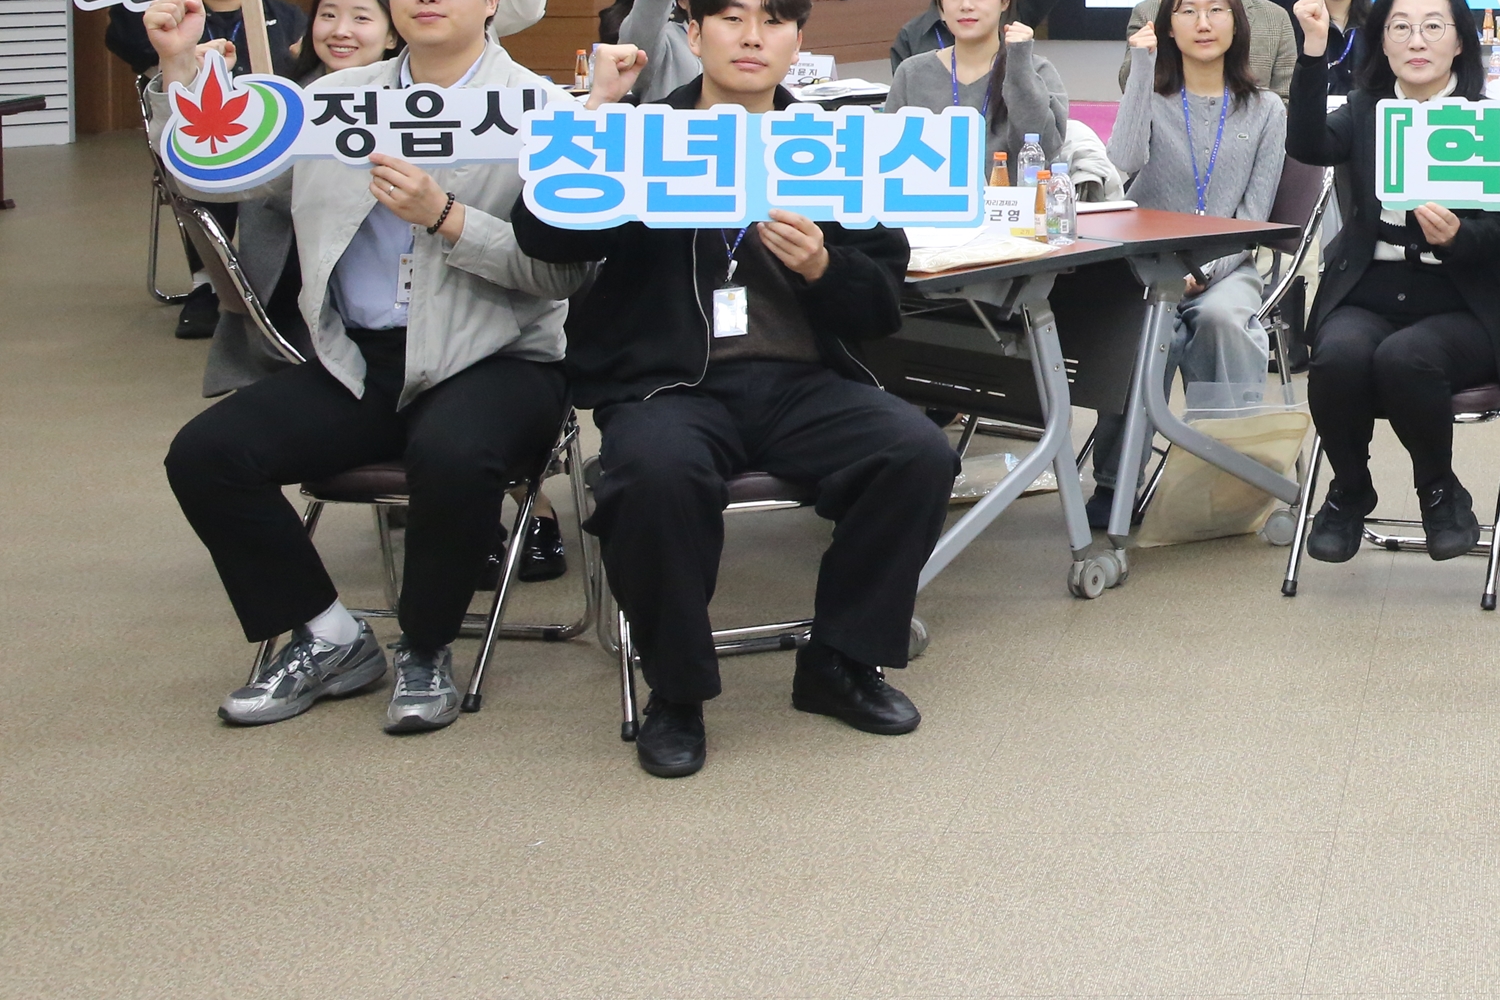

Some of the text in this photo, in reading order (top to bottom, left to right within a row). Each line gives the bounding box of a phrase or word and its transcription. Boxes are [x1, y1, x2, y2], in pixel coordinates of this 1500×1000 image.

[310, 88, 535, 158] 정읍시
[528, 110, 969, 215] 청년 혁신
[983, 209, 1020, 222] 근영
